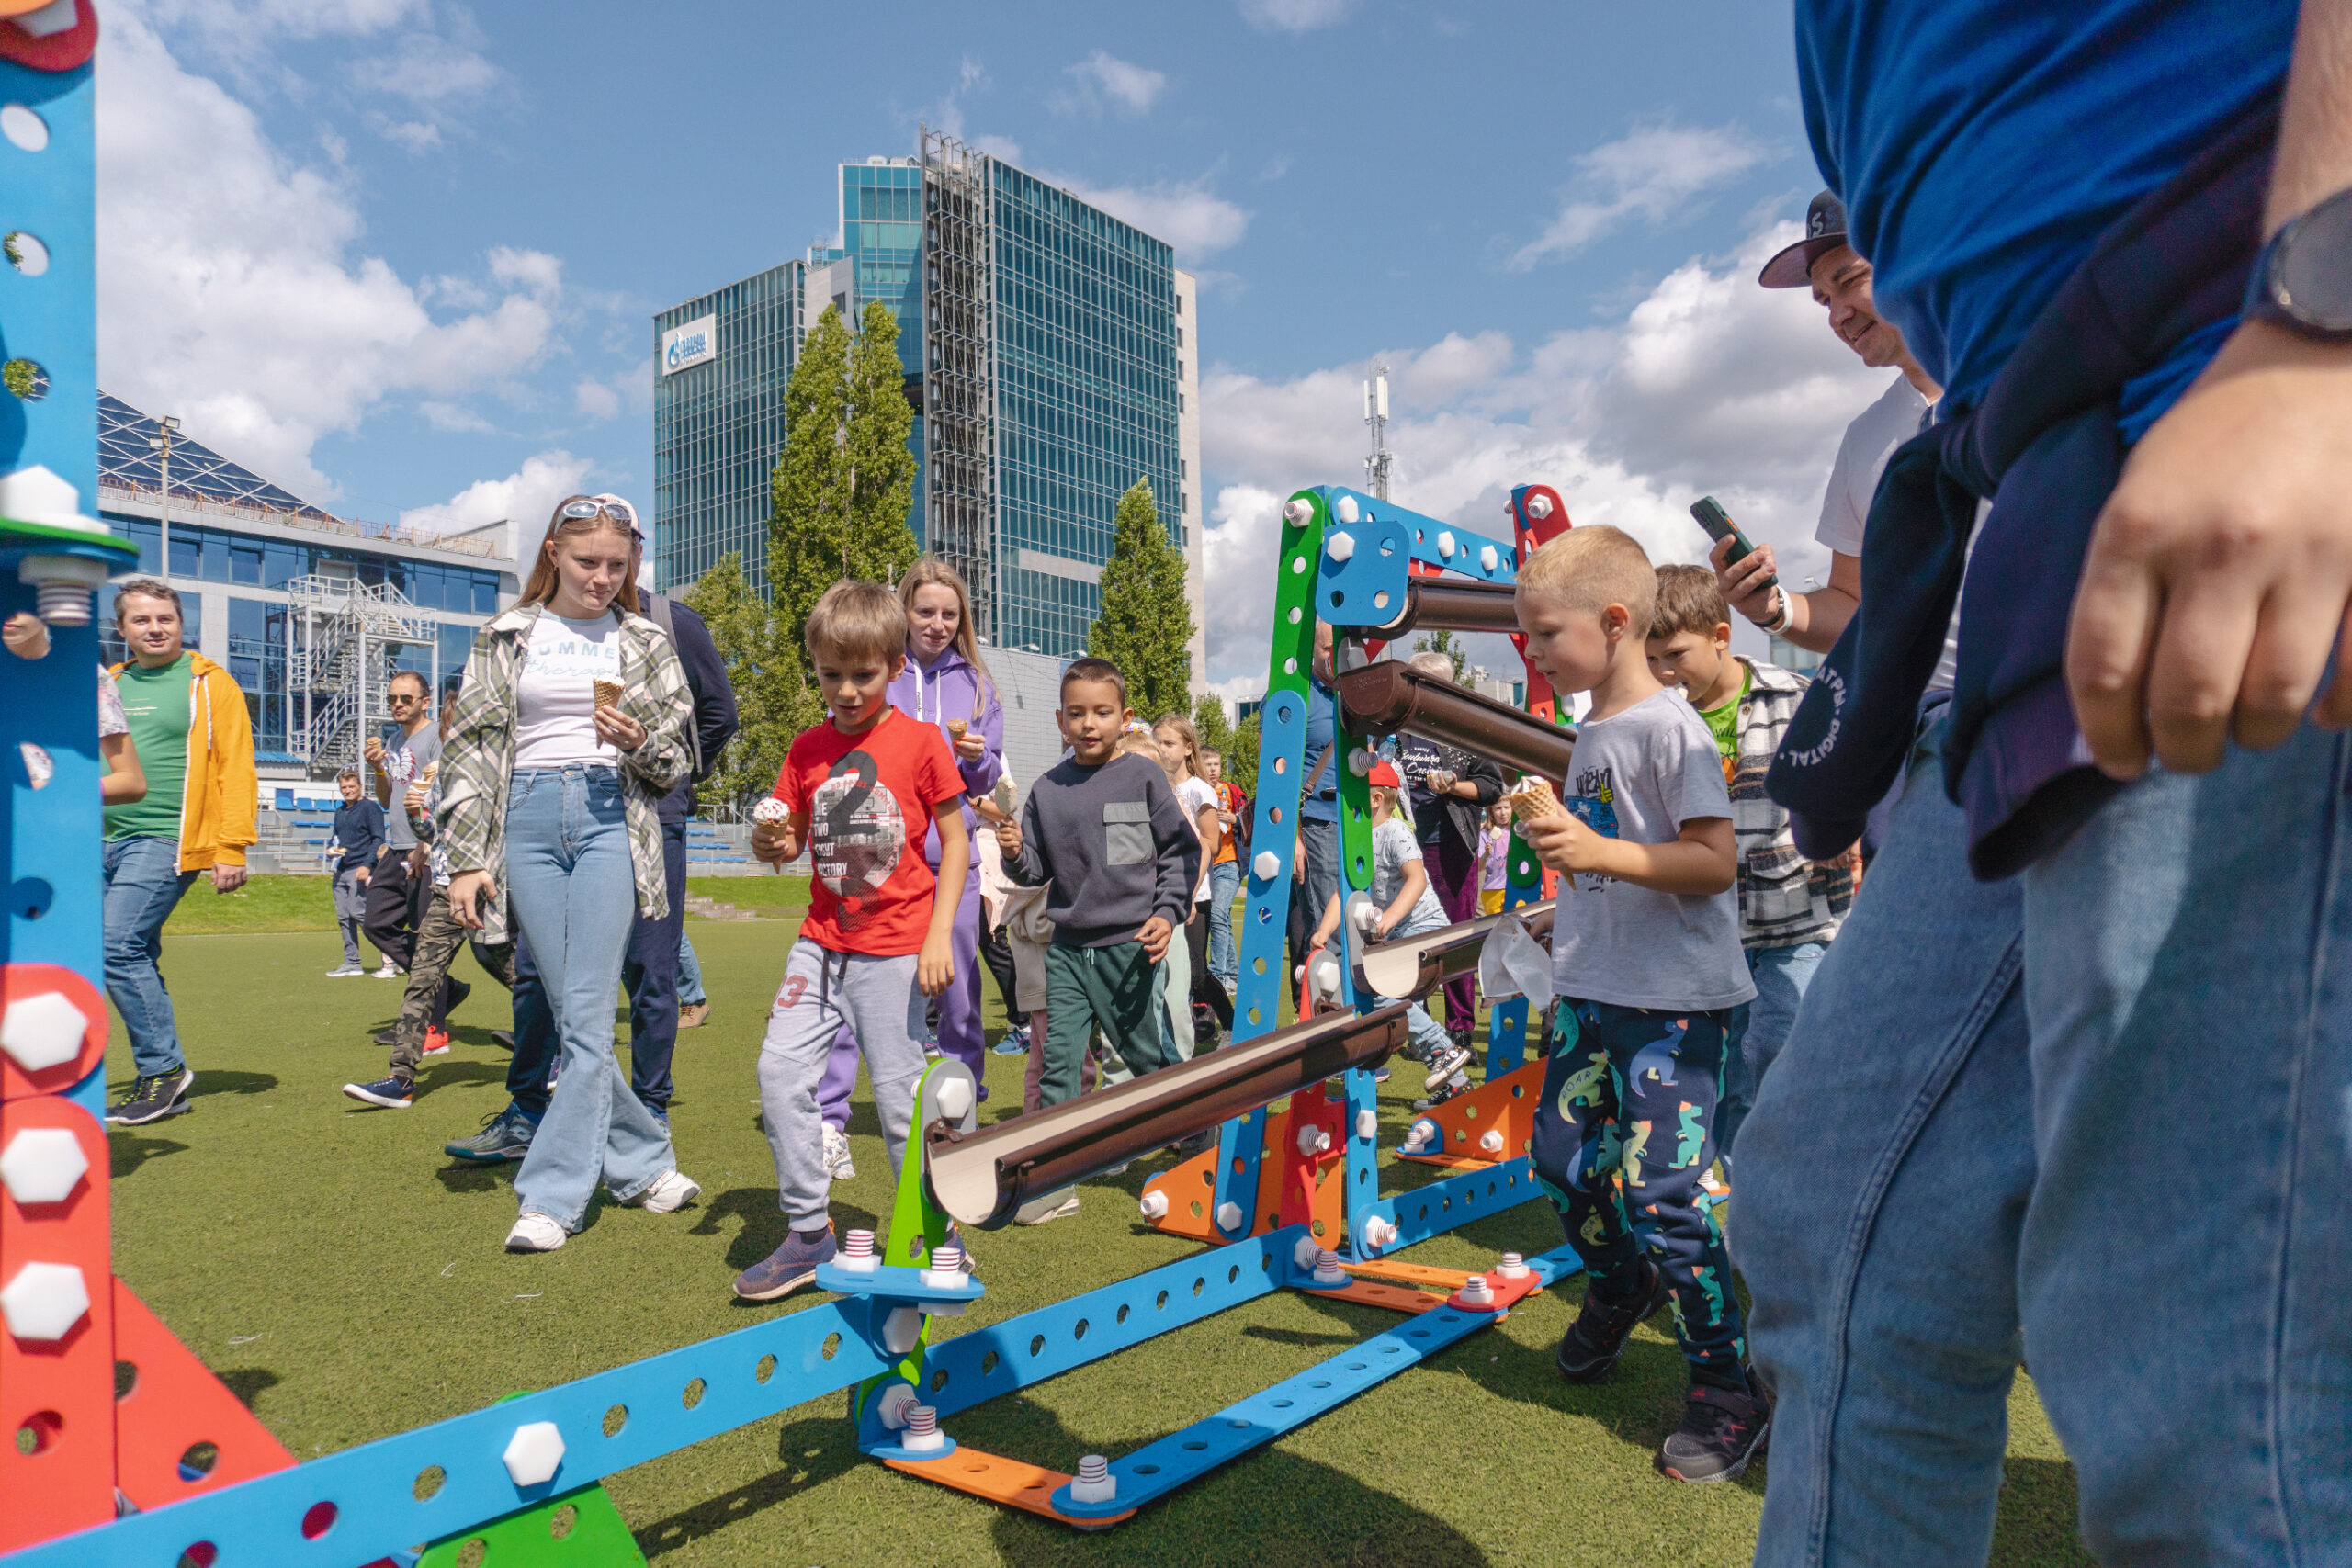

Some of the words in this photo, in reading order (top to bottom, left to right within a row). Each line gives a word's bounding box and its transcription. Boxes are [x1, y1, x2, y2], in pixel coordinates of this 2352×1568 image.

[1807, 206, 1838, 239] SS
[526, 641, 616, 660] UMME
[526, 659, 620, 678] therap
[1789, 717, 1841, 768] DIGITAL
[774, 974, 808, 1009] 3
[1561, 1070, 1591, 1100] ROAR
